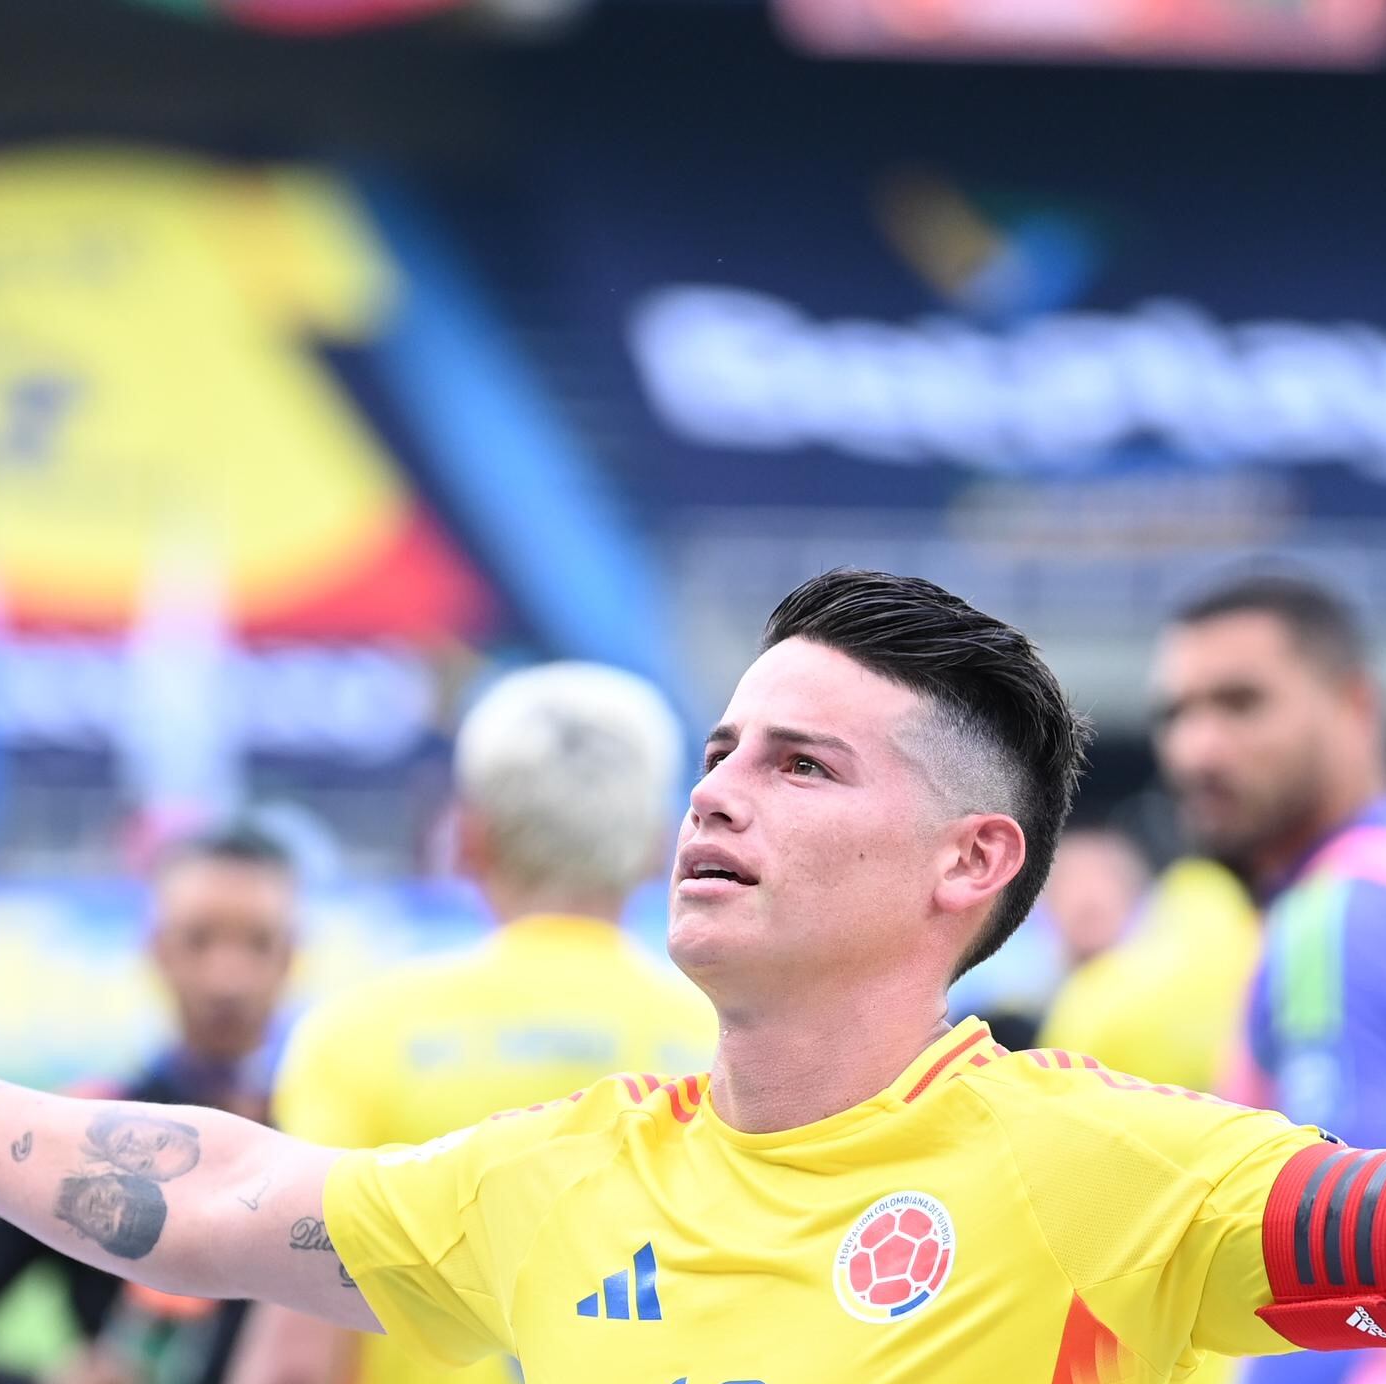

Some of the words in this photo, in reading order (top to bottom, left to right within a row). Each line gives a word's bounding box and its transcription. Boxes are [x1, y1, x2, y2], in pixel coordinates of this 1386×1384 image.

[874, 1195, 929, 1215] COLOMBIANA
[928, 1204, 939, 1216] DE
[936, 1212, 951, 1246] FUTBOL
